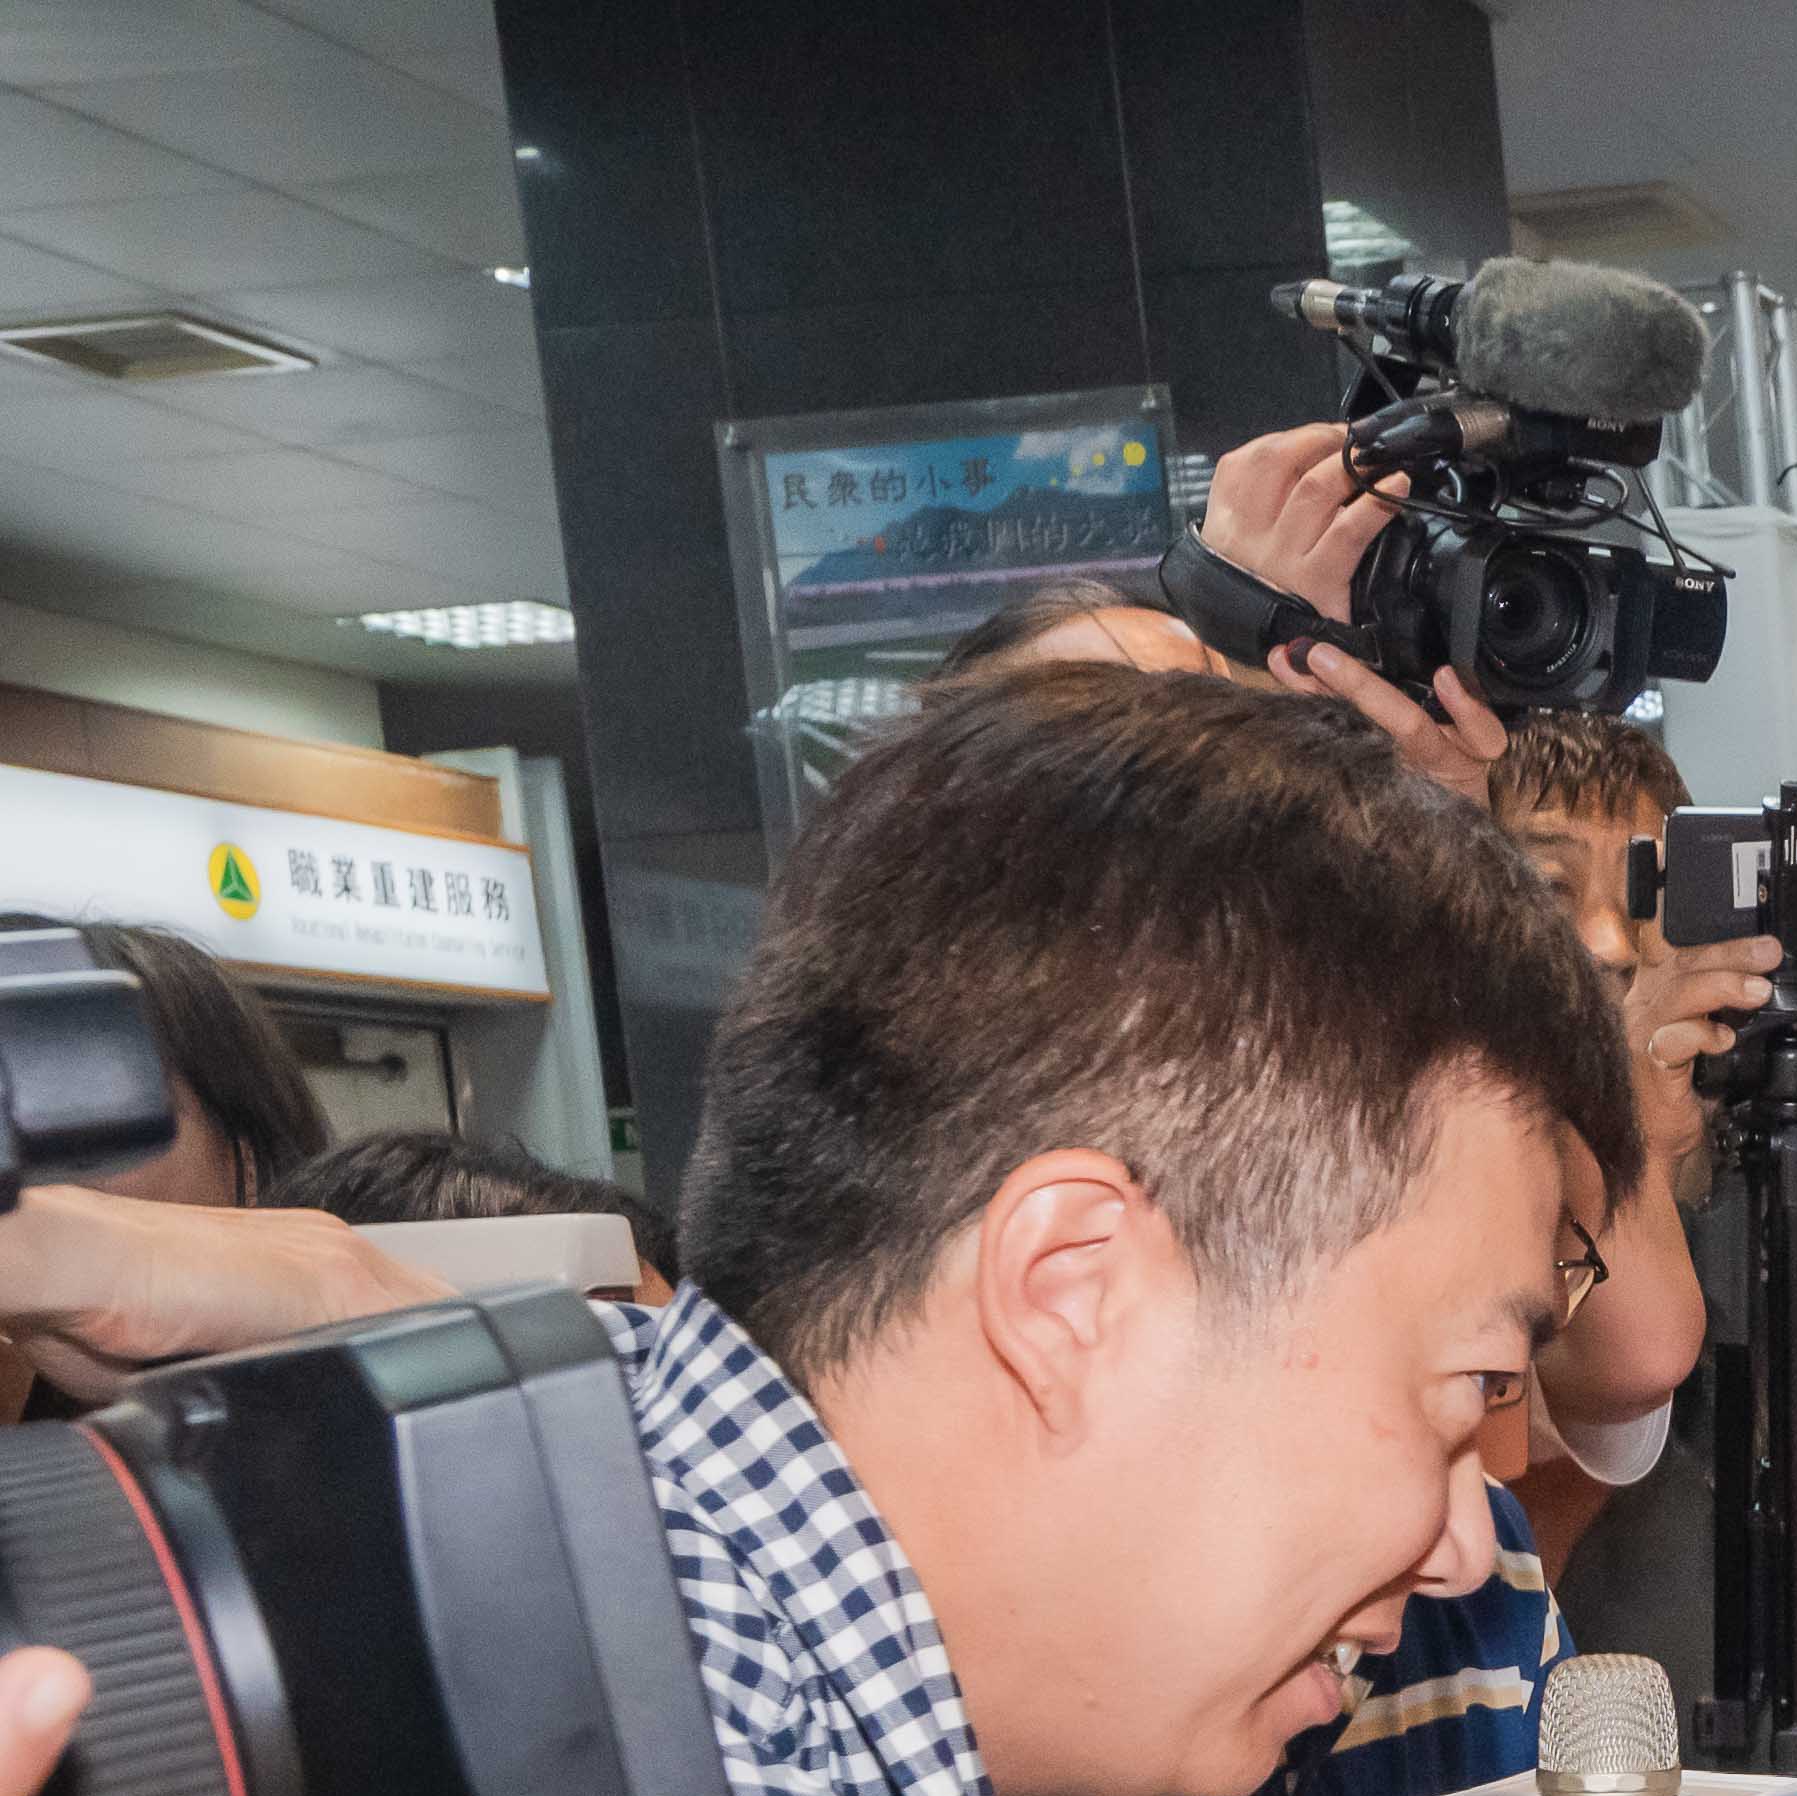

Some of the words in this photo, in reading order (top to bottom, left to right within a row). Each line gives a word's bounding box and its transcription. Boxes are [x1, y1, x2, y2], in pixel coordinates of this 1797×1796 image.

[1675, 576, 1715, 593] SONY
[287, 848, 510, 921] 職業重建服務
